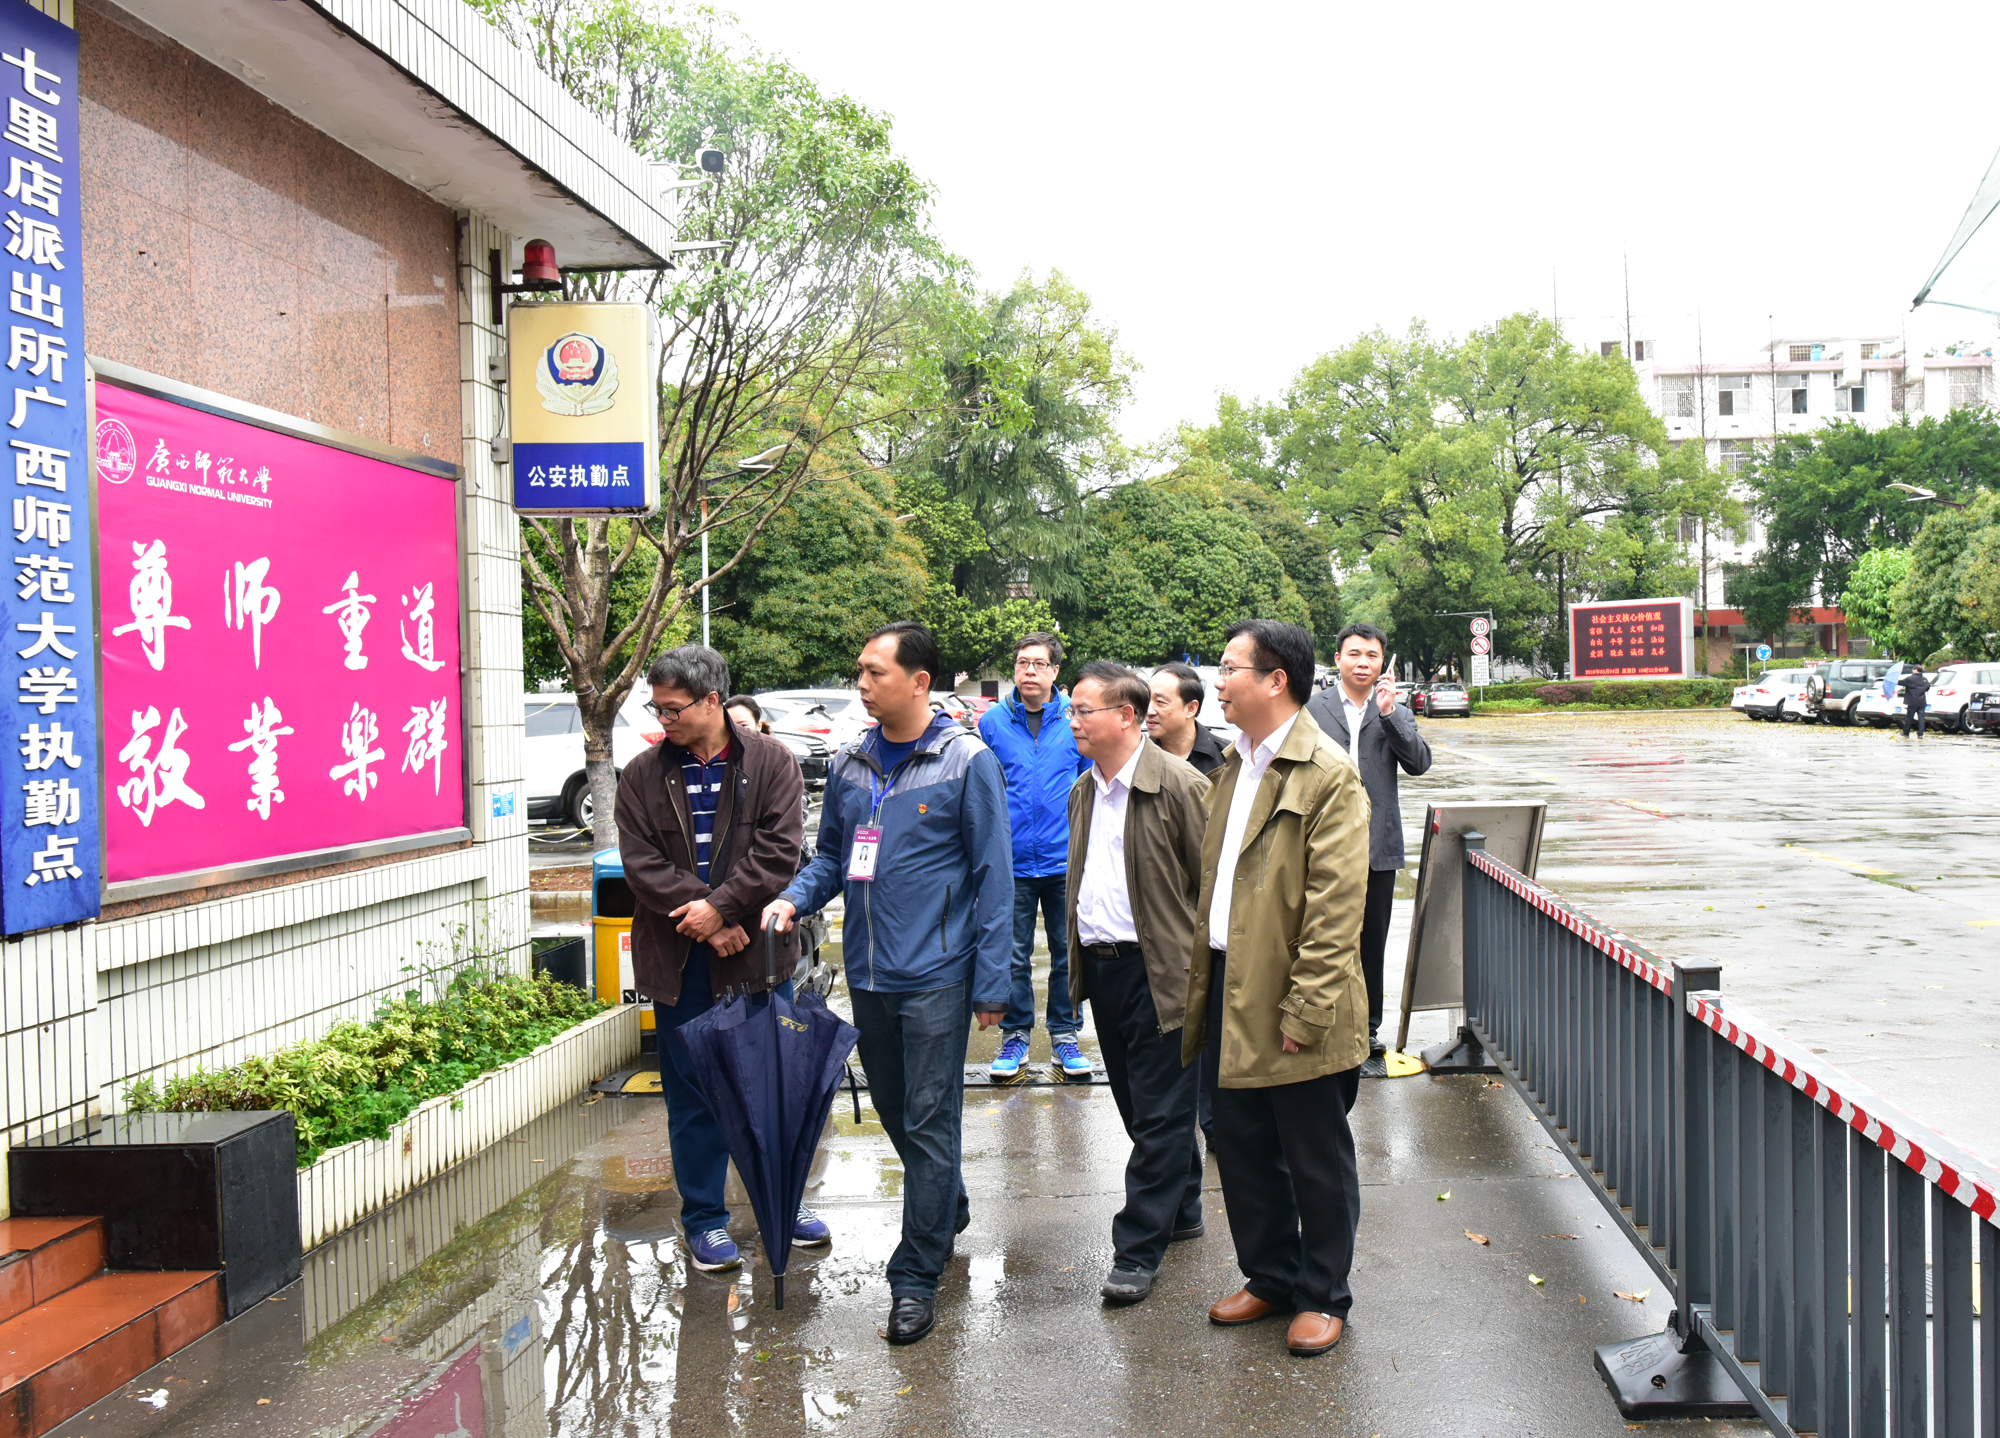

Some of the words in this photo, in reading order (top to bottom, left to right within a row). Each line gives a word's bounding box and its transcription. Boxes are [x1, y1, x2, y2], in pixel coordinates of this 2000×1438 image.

[2, 47, 83, 887] 七里店派出所广西师范大学执勤点
[528, 464, 630, 488] 公安执勤点
[146, 475, 188, 492] GUANGXI
[189, 483, 226, 500] NORMAL
[227, 491, 273, 509] UNIVERSITY
[1591, 611, 1662, 624] 社会主义核心价值观
[1475, 622, 1485, 632] 20
[1589, 627, 1603, 636] 富强
[1609, 625, 1623, 634] 民主
[1630, 624, 1644, 633] 文明
[1590, 638, 1603, 646] 自由
[1610, 637, 1624, 646] 平等
[1630, 637, 1644, 645] 公正
[1650, 636, 1665, 644] 法治
[1590, 649, 1604, 658] 爱国
[1630, 648, 1644, 656] 诚信
[1651, 647, 1665, 656] 友善
